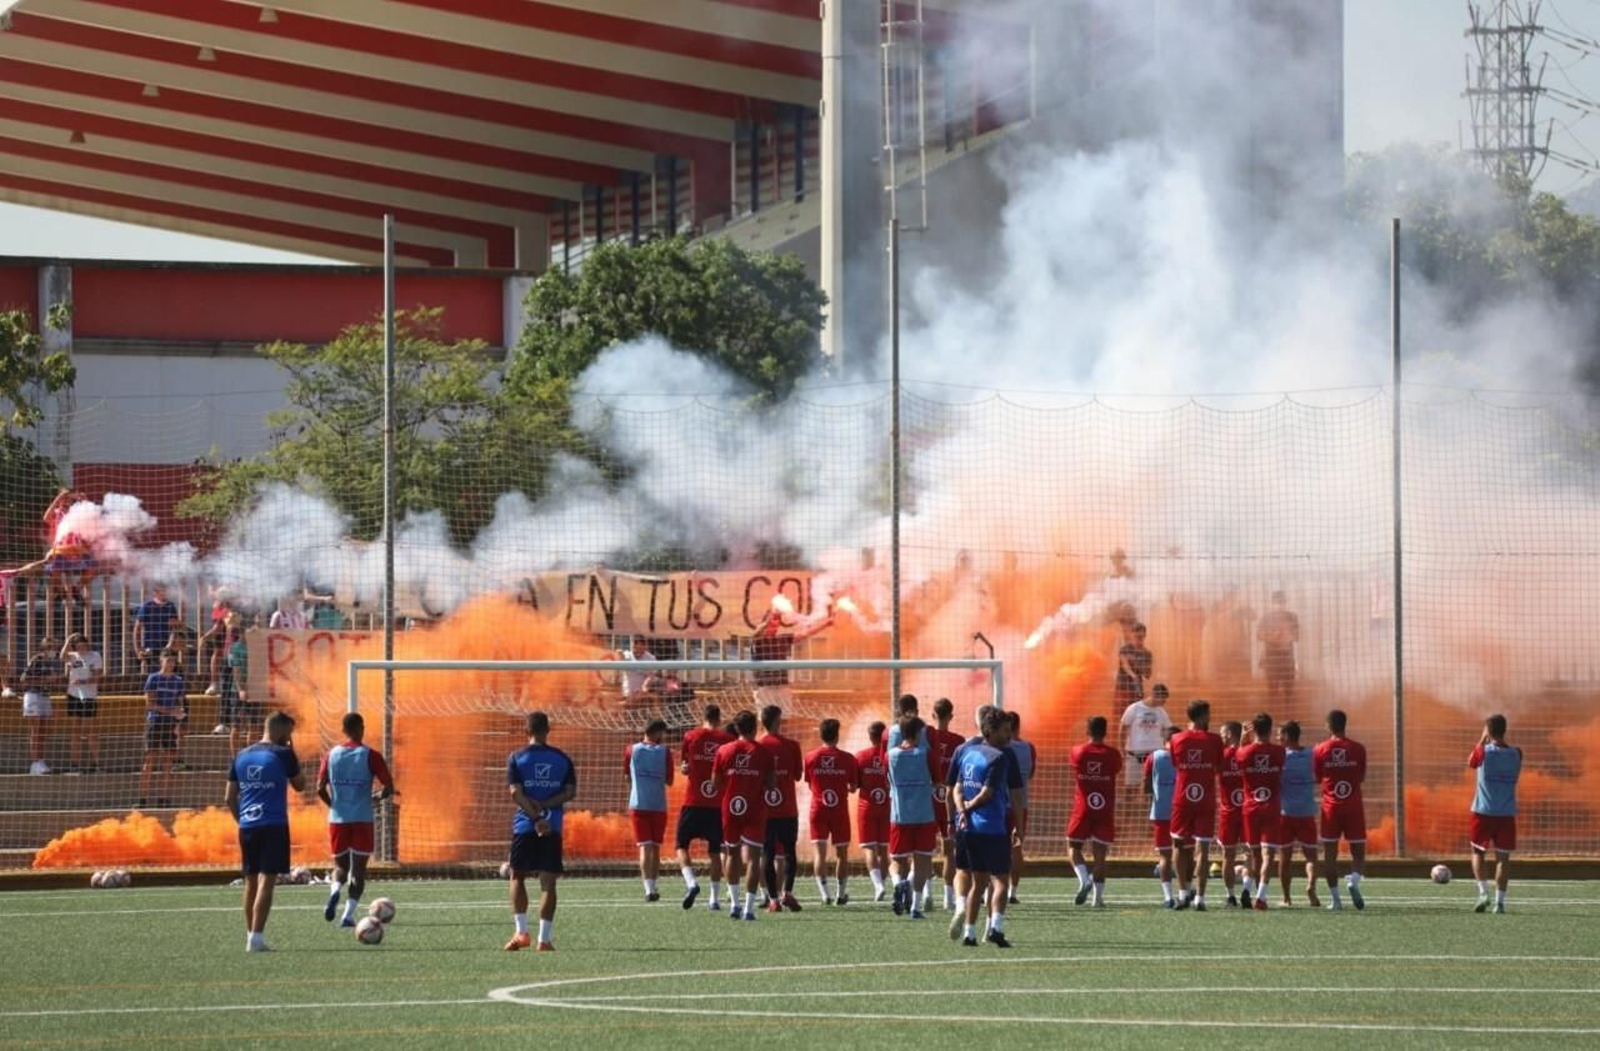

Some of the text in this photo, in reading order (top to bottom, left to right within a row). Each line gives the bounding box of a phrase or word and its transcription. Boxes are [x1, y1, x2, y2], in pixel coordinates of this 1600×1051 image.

[640, 578, 722, 632] TUS
[743, 576, 814, 631] CO
[524, 780, 561, 788] GIVOVA
